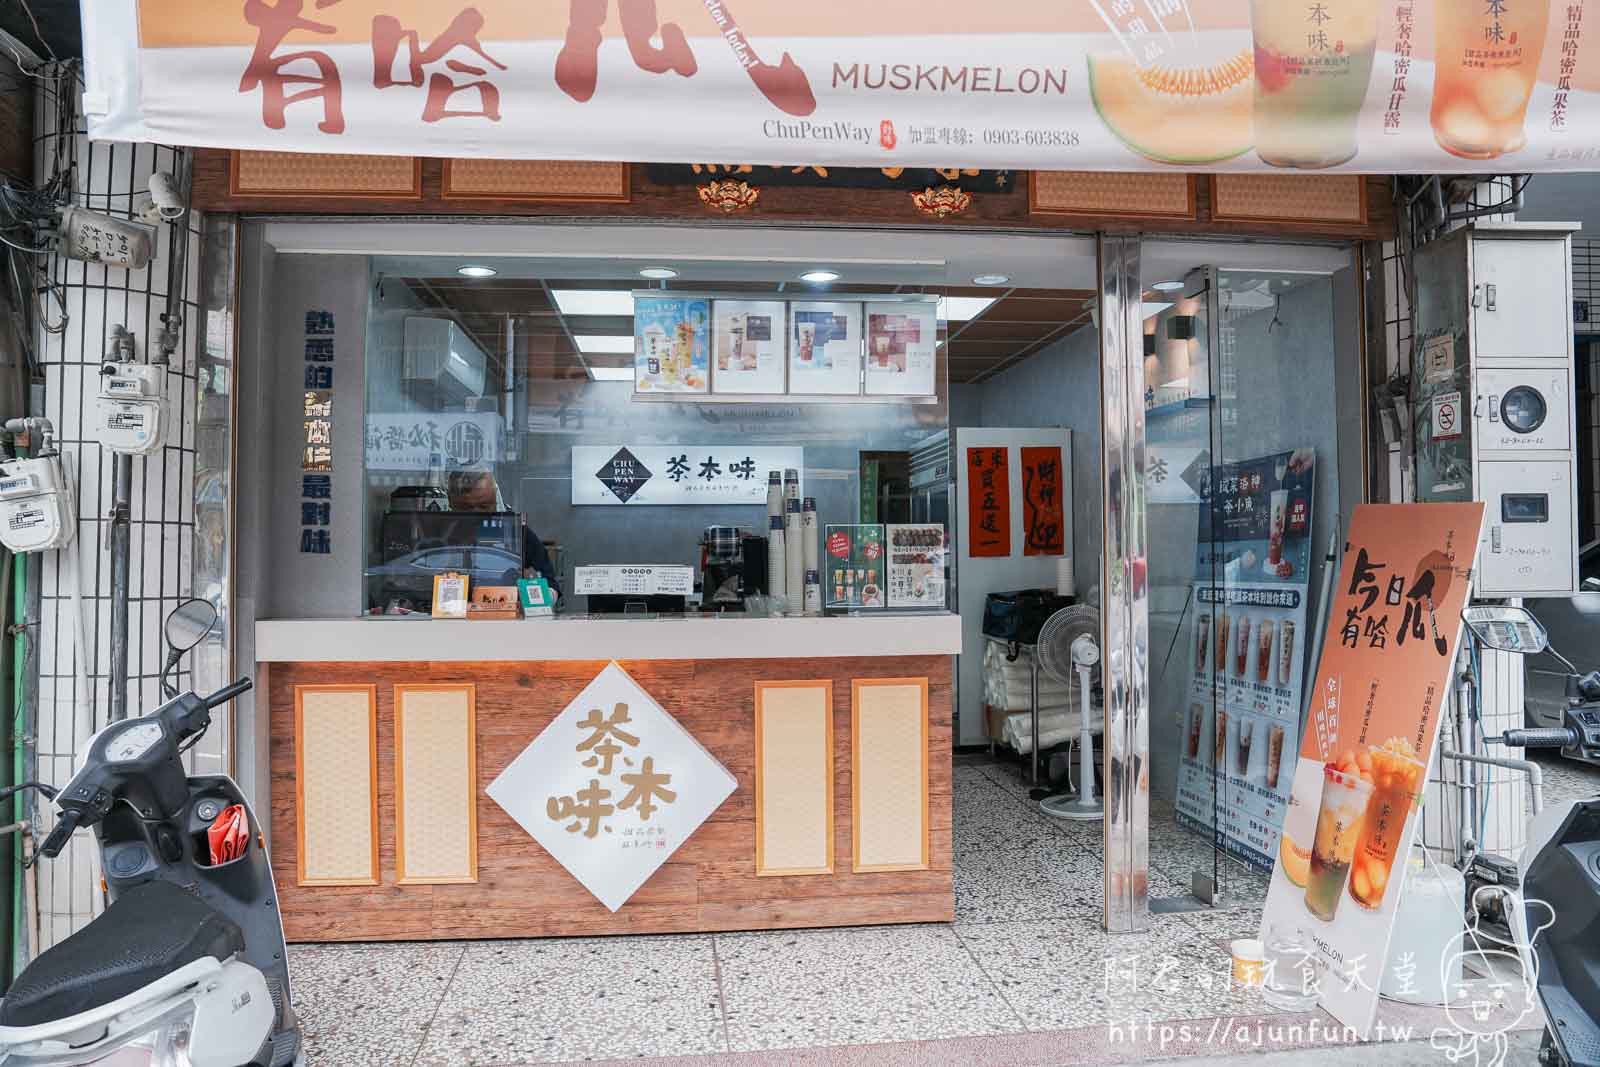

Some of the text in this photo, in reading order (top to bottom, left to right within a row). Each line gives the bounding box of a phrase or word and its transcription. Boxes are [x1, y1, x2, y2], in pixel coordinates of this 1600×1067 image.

[831, 61, 1067, 95] MUSKMELON
[763, 119, 873, 145] ChuPenWay
[983, 127, 1080, 146] 0903-603838
[613, 459, 635, 468] CHU
[615, 467, 635, 476] PEN
[665, 453, 756, 483] 茶本味
[614, 476, 635, 484] WAY
[1347, 547, 1405, 613] 今日
[1340, 607, 1389, 650] 有哈
